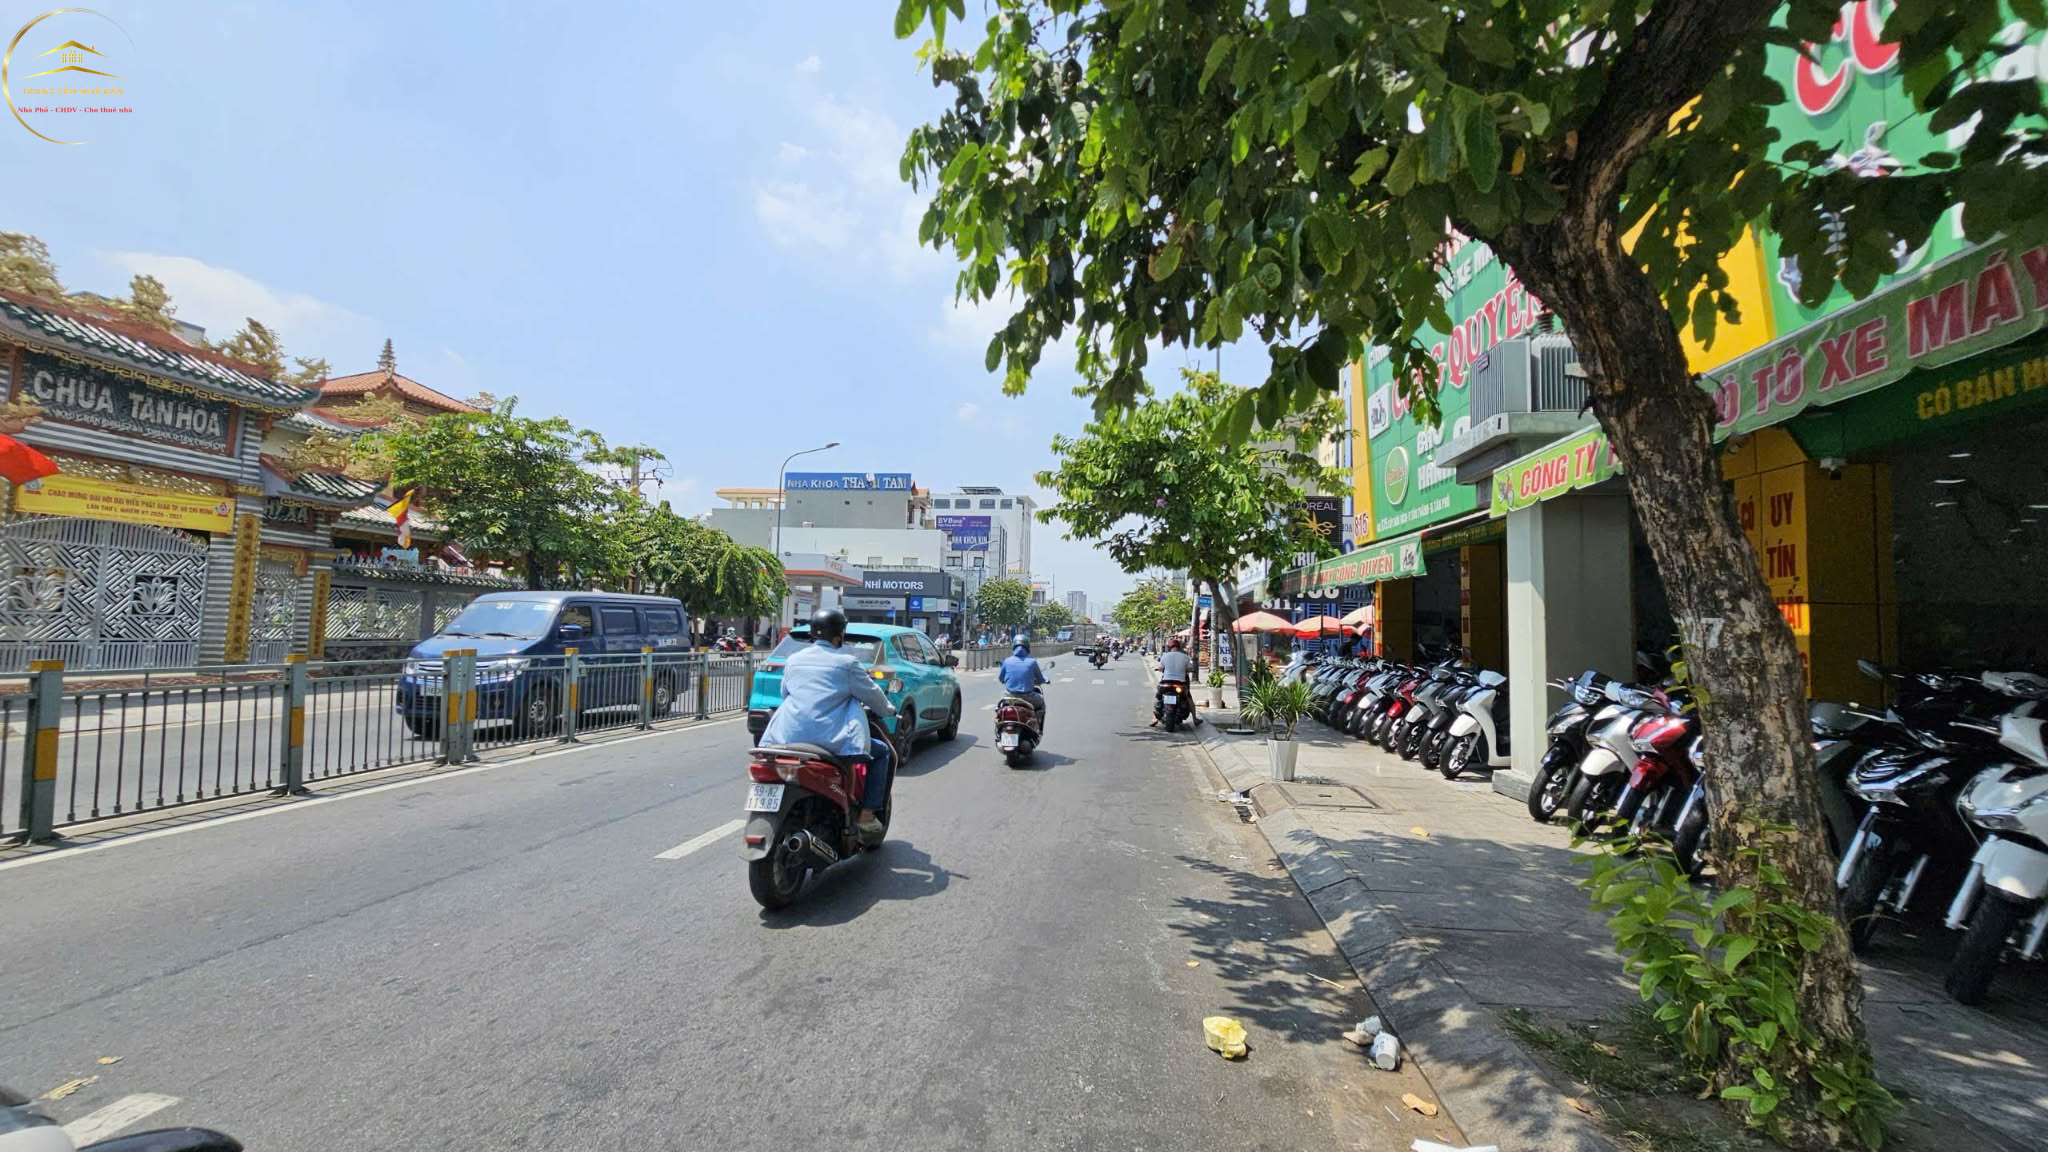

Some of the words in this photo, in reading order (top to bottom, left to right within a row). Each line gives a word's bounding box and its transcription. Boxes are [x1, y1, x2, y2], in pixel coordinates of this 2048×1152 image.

[1520, 459, 1569, 499] CÔNG
[1575, 439, 1601, 480] TY
[1751, 345, 1806, 415] TÔ
[1818, 316, 1889, 391] XE
[787, 479, 808, 489] NHA
[811, 479, 839, 489] KHOA
[1770, 491, 1794, 528] UY
[1766, 537, 1797, 580] TÍN
[865, 578, 881, 589] NHÍ
[883, 581, 924, 590] MOTORS
